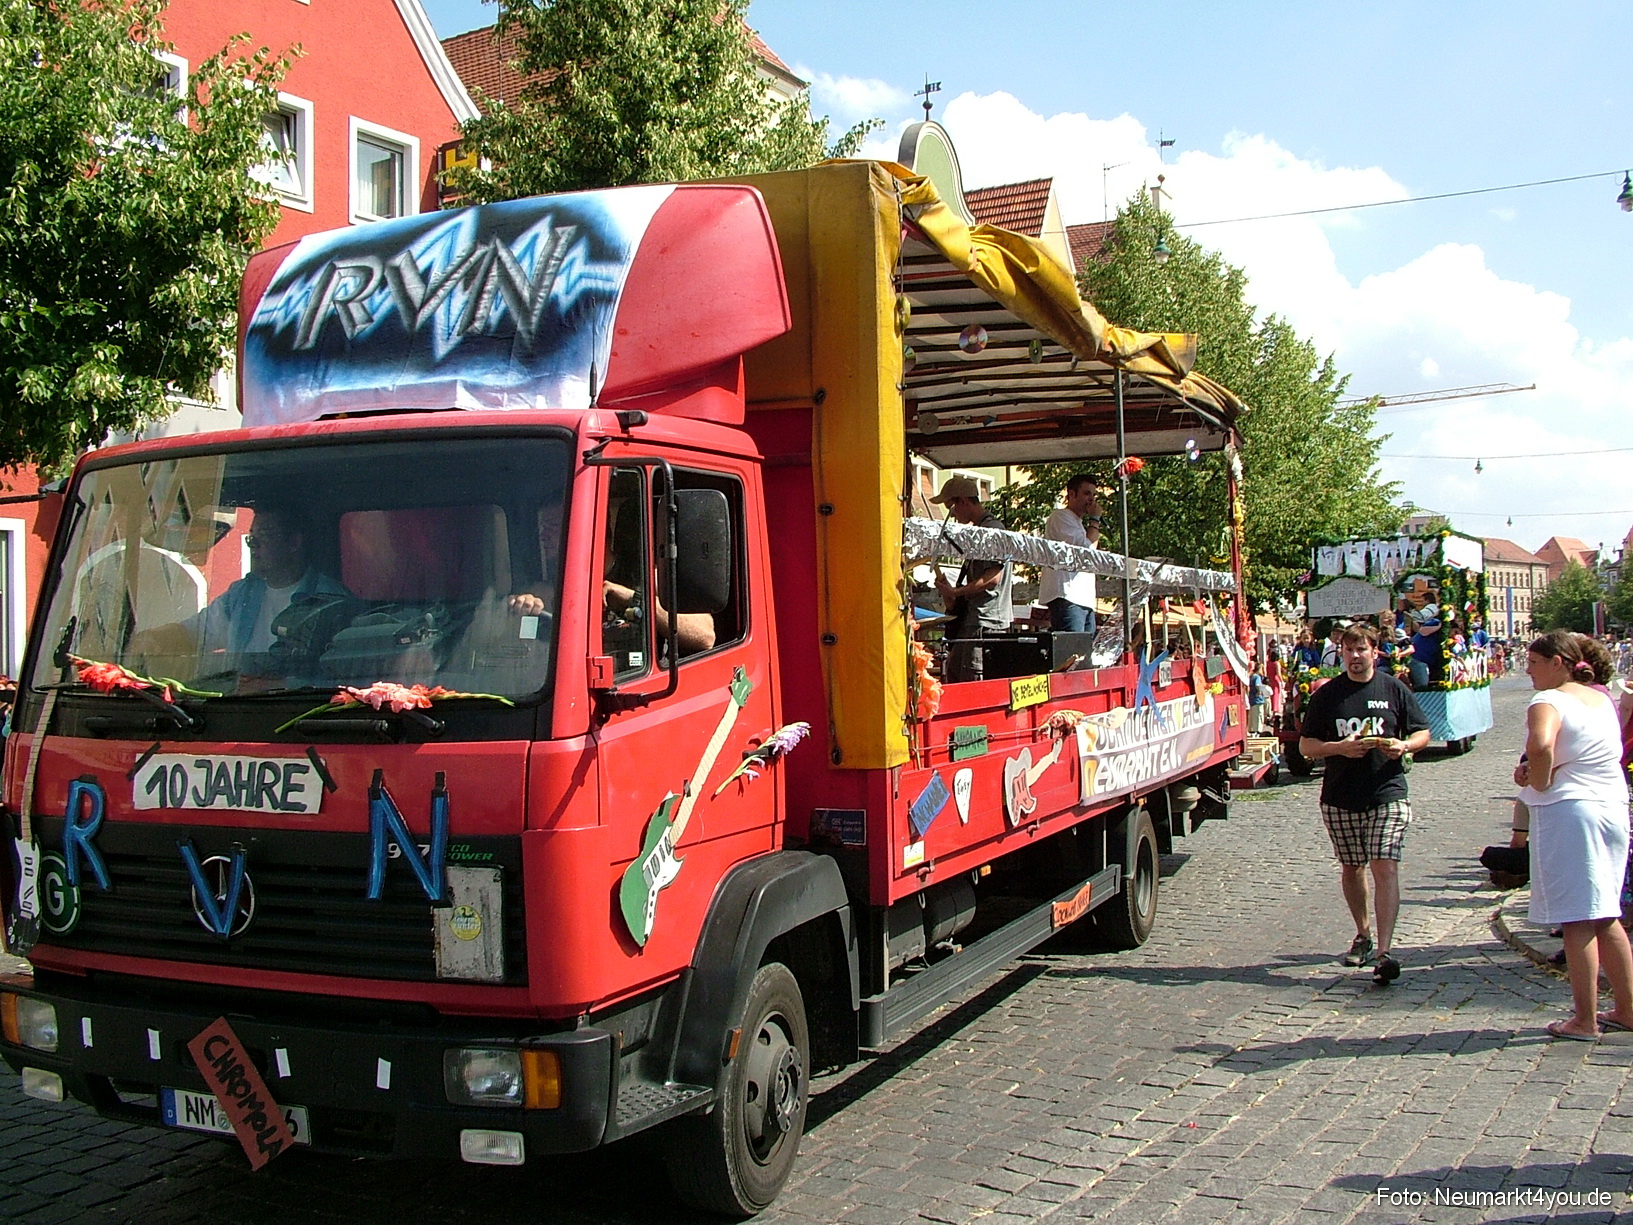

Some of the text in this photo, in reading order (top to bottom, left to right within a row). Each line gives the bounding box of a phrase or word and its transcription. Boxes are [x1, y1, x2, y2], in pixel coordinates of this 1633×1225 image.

[293, 225, 577, 352] RVN
[1367, 700, 1389, 709] RVN
[145, 758, 309, 812] 10 JAHRE
[184, 1095, 216, 1127] NM
